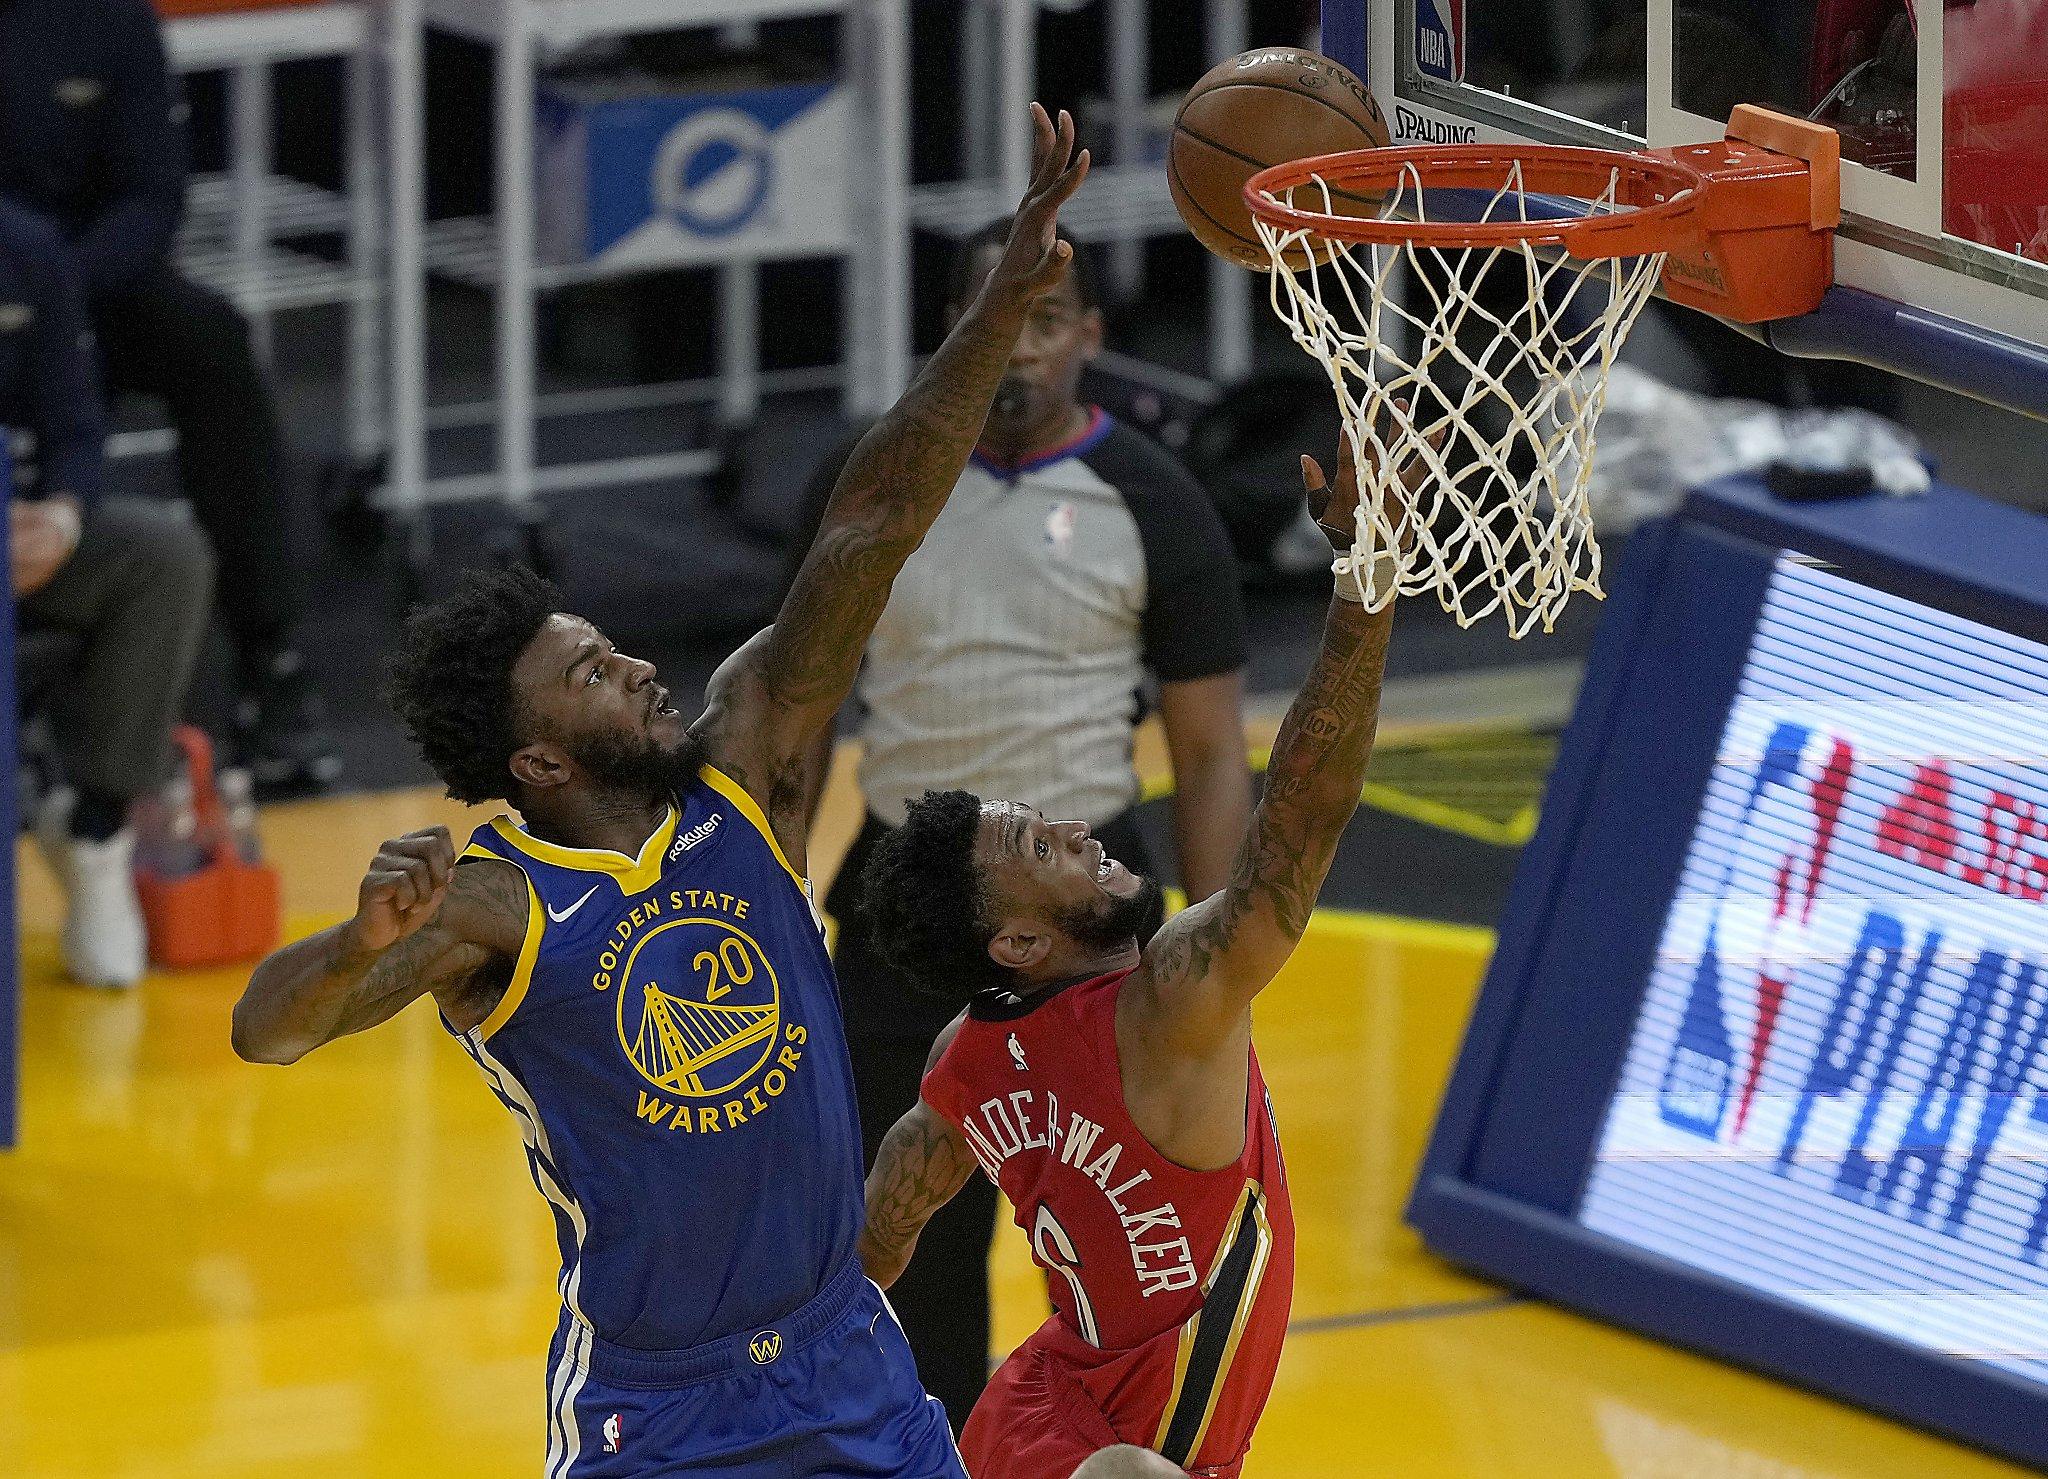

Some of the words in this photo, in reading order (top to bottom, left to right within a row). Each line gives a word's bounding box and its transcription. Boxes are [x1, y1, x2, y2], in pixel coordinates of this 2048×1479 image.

[1421, 27, 1446, 69] NBA
[1395, 104, 1476, 144] SPALDING
[592, 897, 661, 991] GOLDEN
[671, 889, 751, 920] STATE
[693, 937, 754, 1003] 20
[635, 1022, 809, 1134] WARRIORS
[750, 1334, 782, 1363] W
